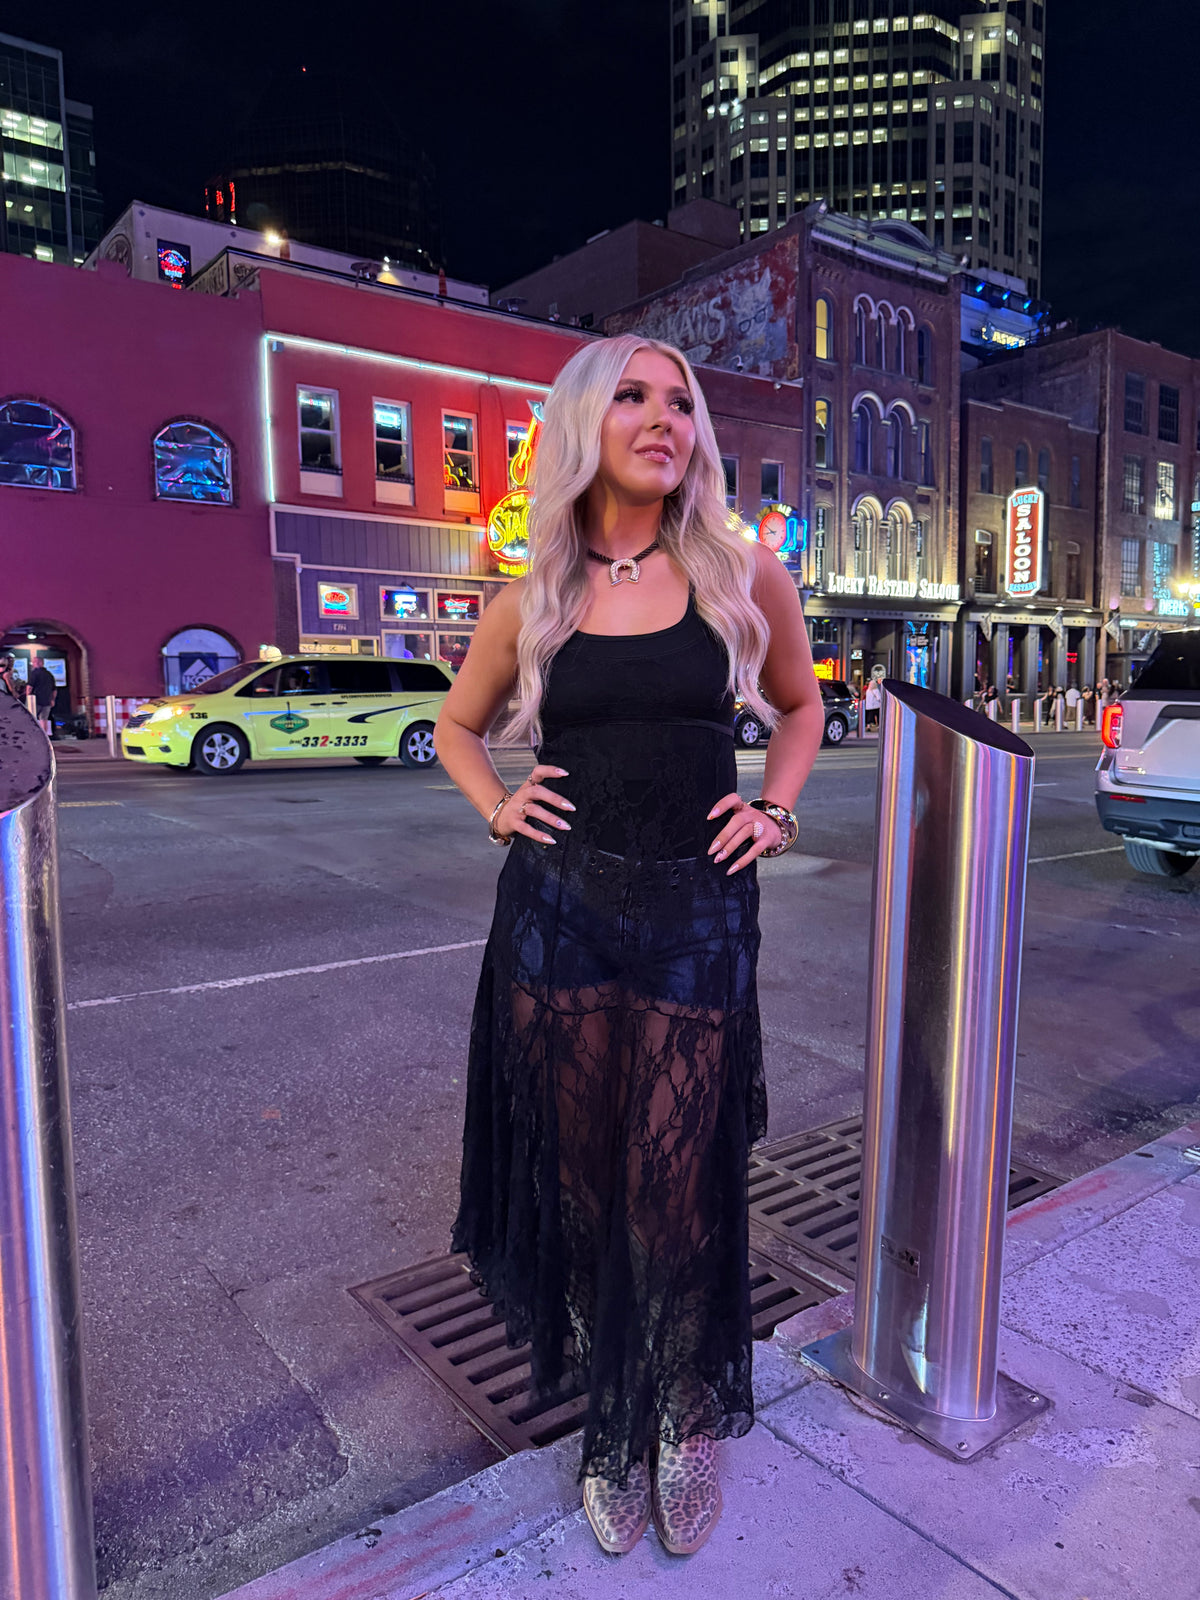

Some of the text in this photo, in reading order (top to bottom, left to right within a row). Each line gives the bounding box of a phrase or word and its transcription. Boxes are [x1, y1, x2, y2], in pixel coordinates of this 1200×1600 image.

[1012, 494, 1039, 507] LUCKY
[1013, 504, 1032, 583] SALOON
[828, 572, 960, 601] LUCKY BASTARD SALOON
[302, 736, 368, 747] 332-3333
